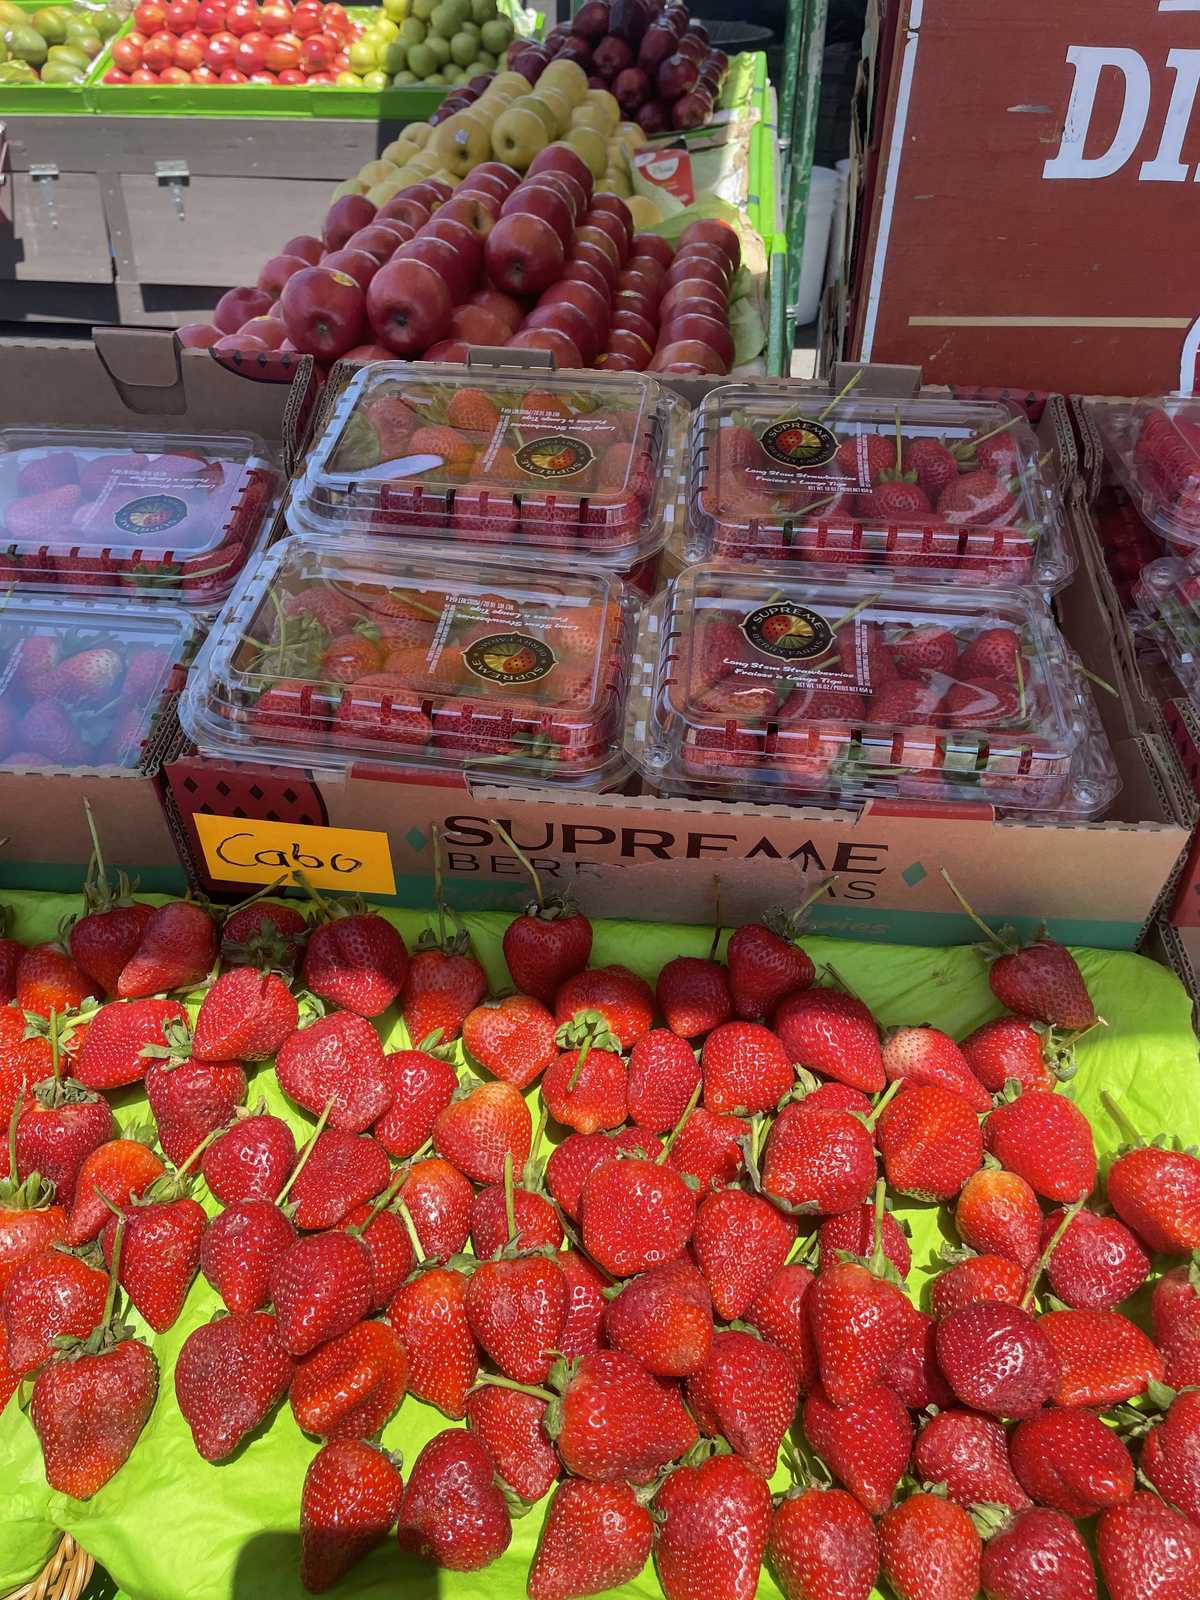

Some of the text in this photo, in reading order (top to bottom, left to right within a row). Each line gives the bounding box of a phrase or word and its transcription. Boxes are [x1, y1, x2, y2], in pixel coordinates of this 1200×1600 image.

[1042, 45, 1200, 182] DI
[768, 422, 830, 441] SUPREME
[745, 467, 766, 475] Long
[752, 606, 824, 630] SUPREME
[471, 660, 544, 681] SUPREME
[723, 658, 854, 678] Long Stem Strawberries
[216, 833, 362, 872] Cabo
[444, 815, 889, 874] SUPREME
[447, 852, 625, 880] BERR
